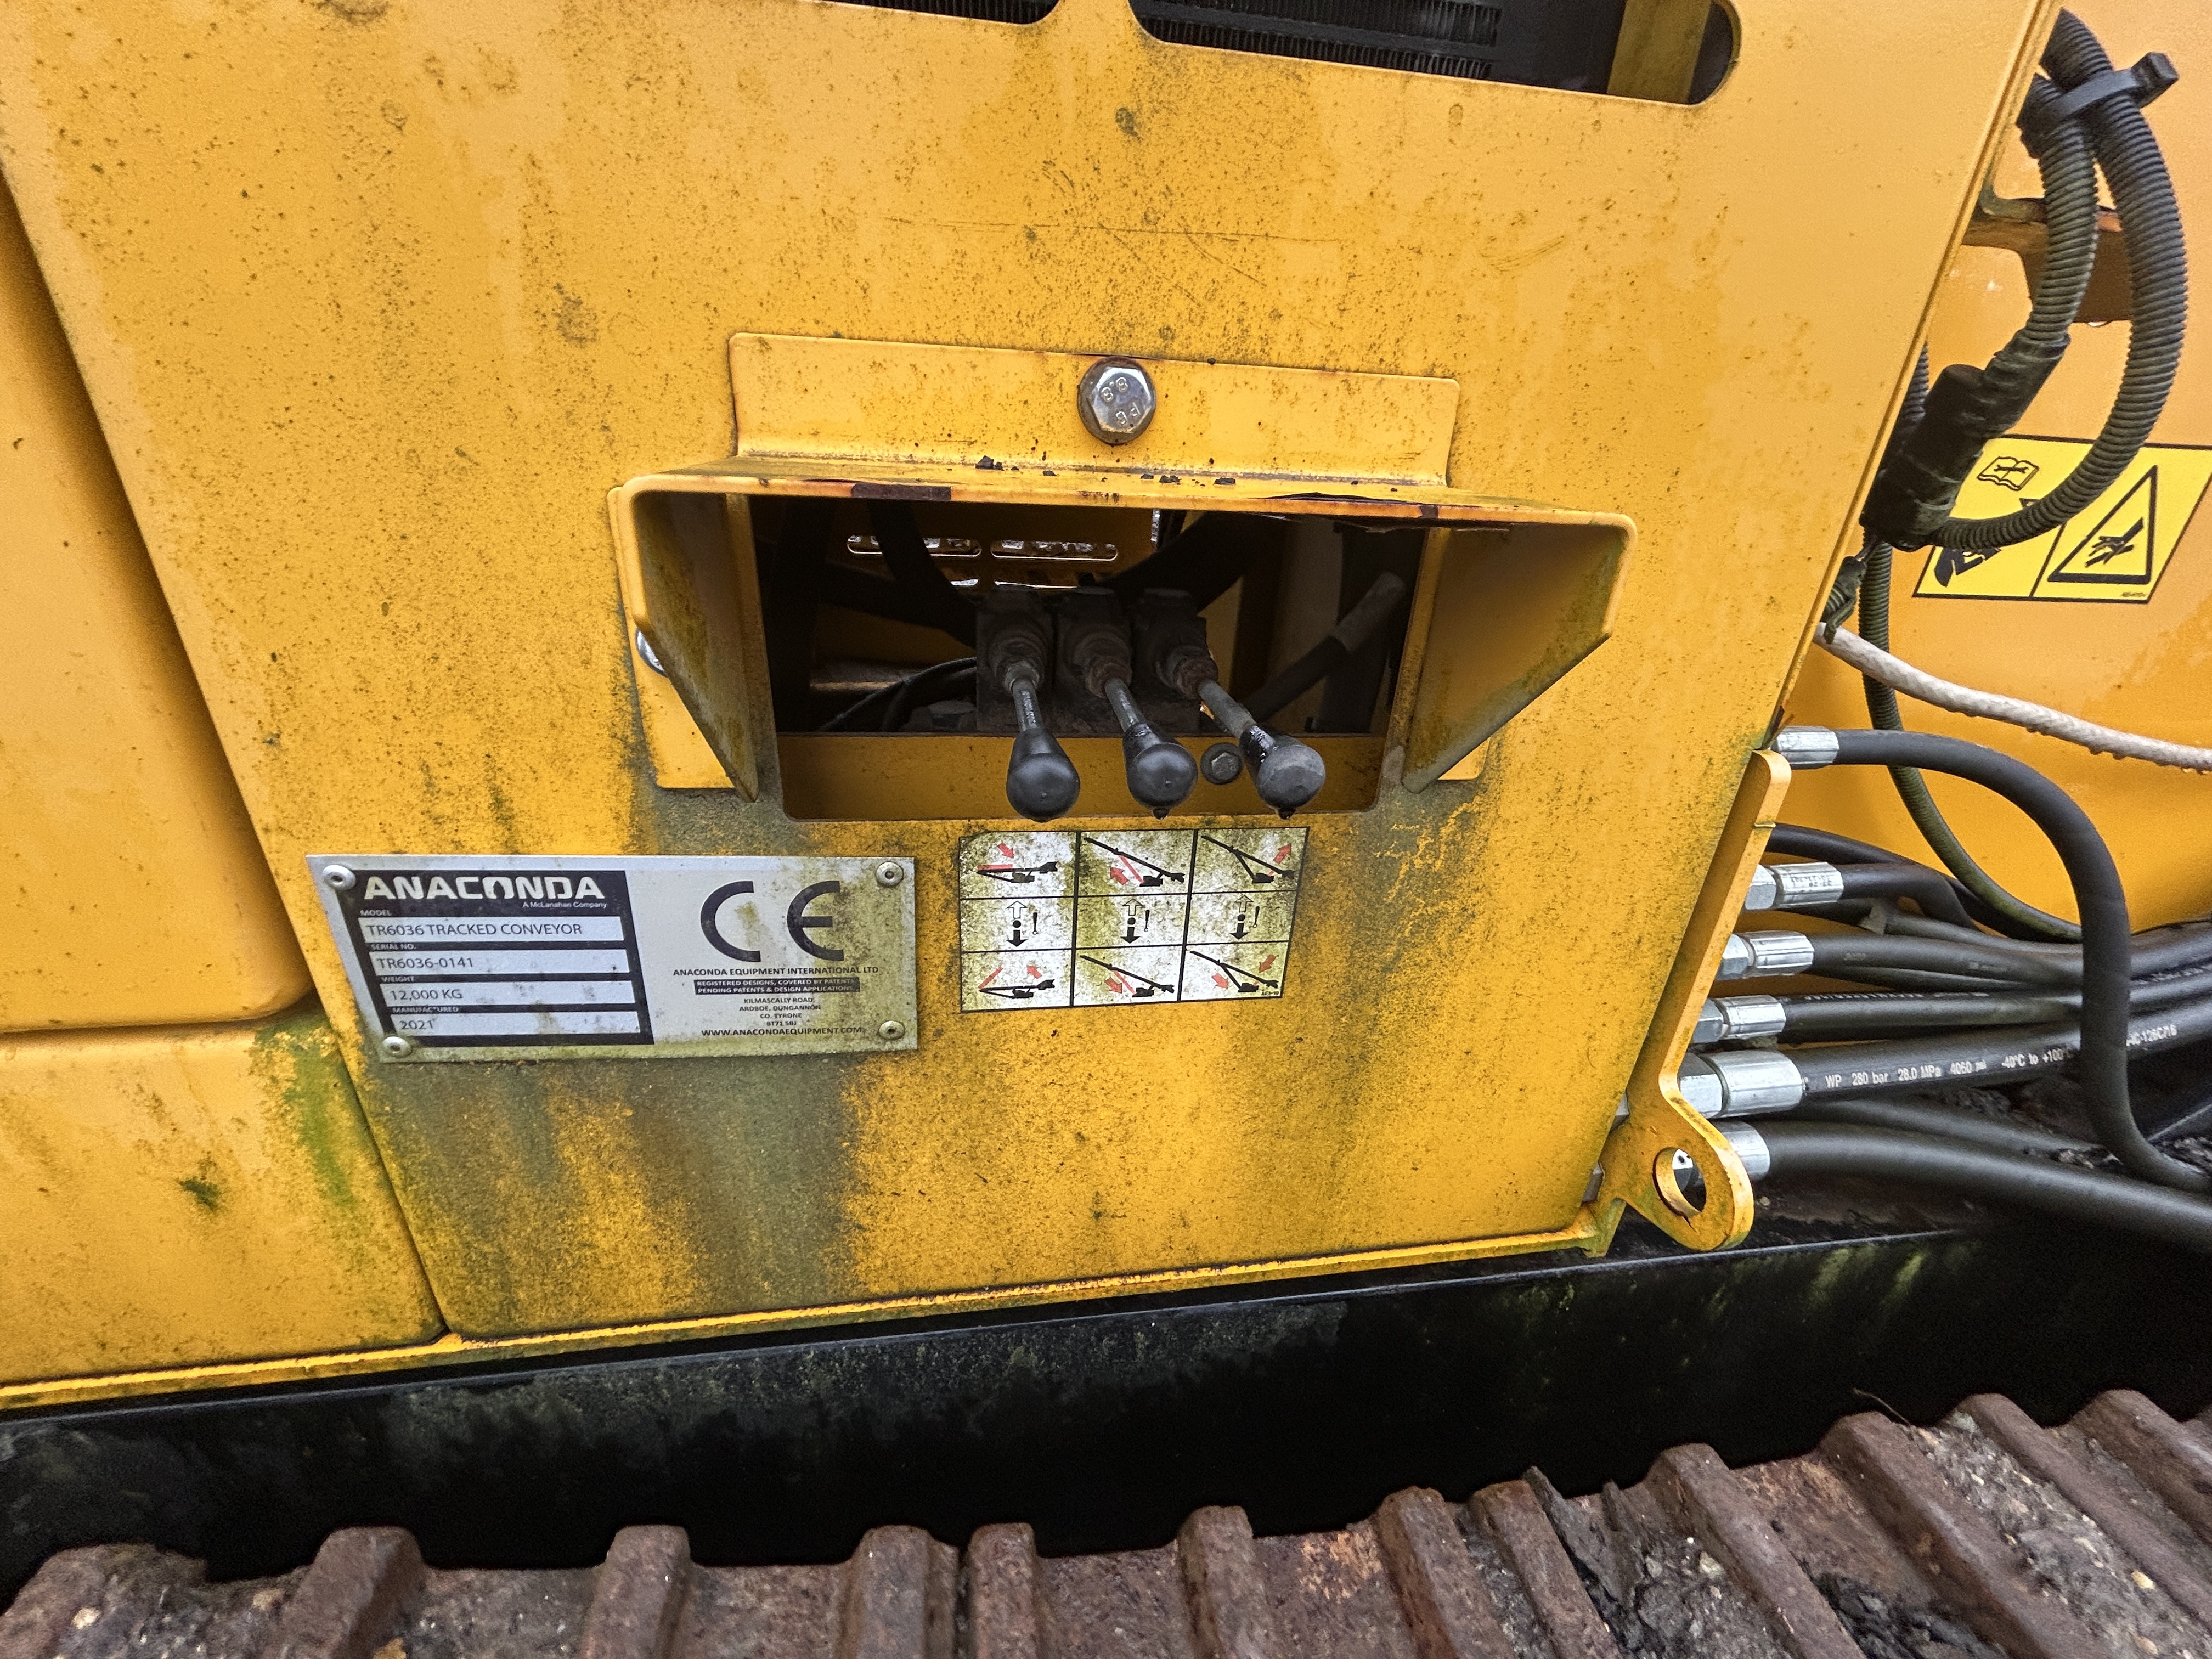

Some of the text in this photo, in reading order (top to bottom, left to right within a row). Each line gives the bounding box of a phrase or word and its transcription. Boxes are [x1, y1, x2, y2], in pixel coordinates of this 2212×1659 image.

[364, 876, 605, 900] ANACONDA
[366, 923, 582, 935] TR6036 TRACKED CONVEYOR
[377, 957, 473, 969] TR6036-0141
[390, 989, 462, 1001] 12,000 KG
[399, 1020, 433, 1030] 2021
[701, 1026, 862, 1036] WWW.ANACONDAEQUIPMENT.COM
[1825, 1074, 1842, 1088] WP
[1852, 1071, 1869, 1086] 280
[1872, 1071, 1888, 1084] bar
[1898, 1066, 1917, 1081] 28.0
[1921, 1064, 1942, 1079] MPa
[1950, 1061, 1972, 1075] 4060
[2028, 1052, 2039, 1065] to
